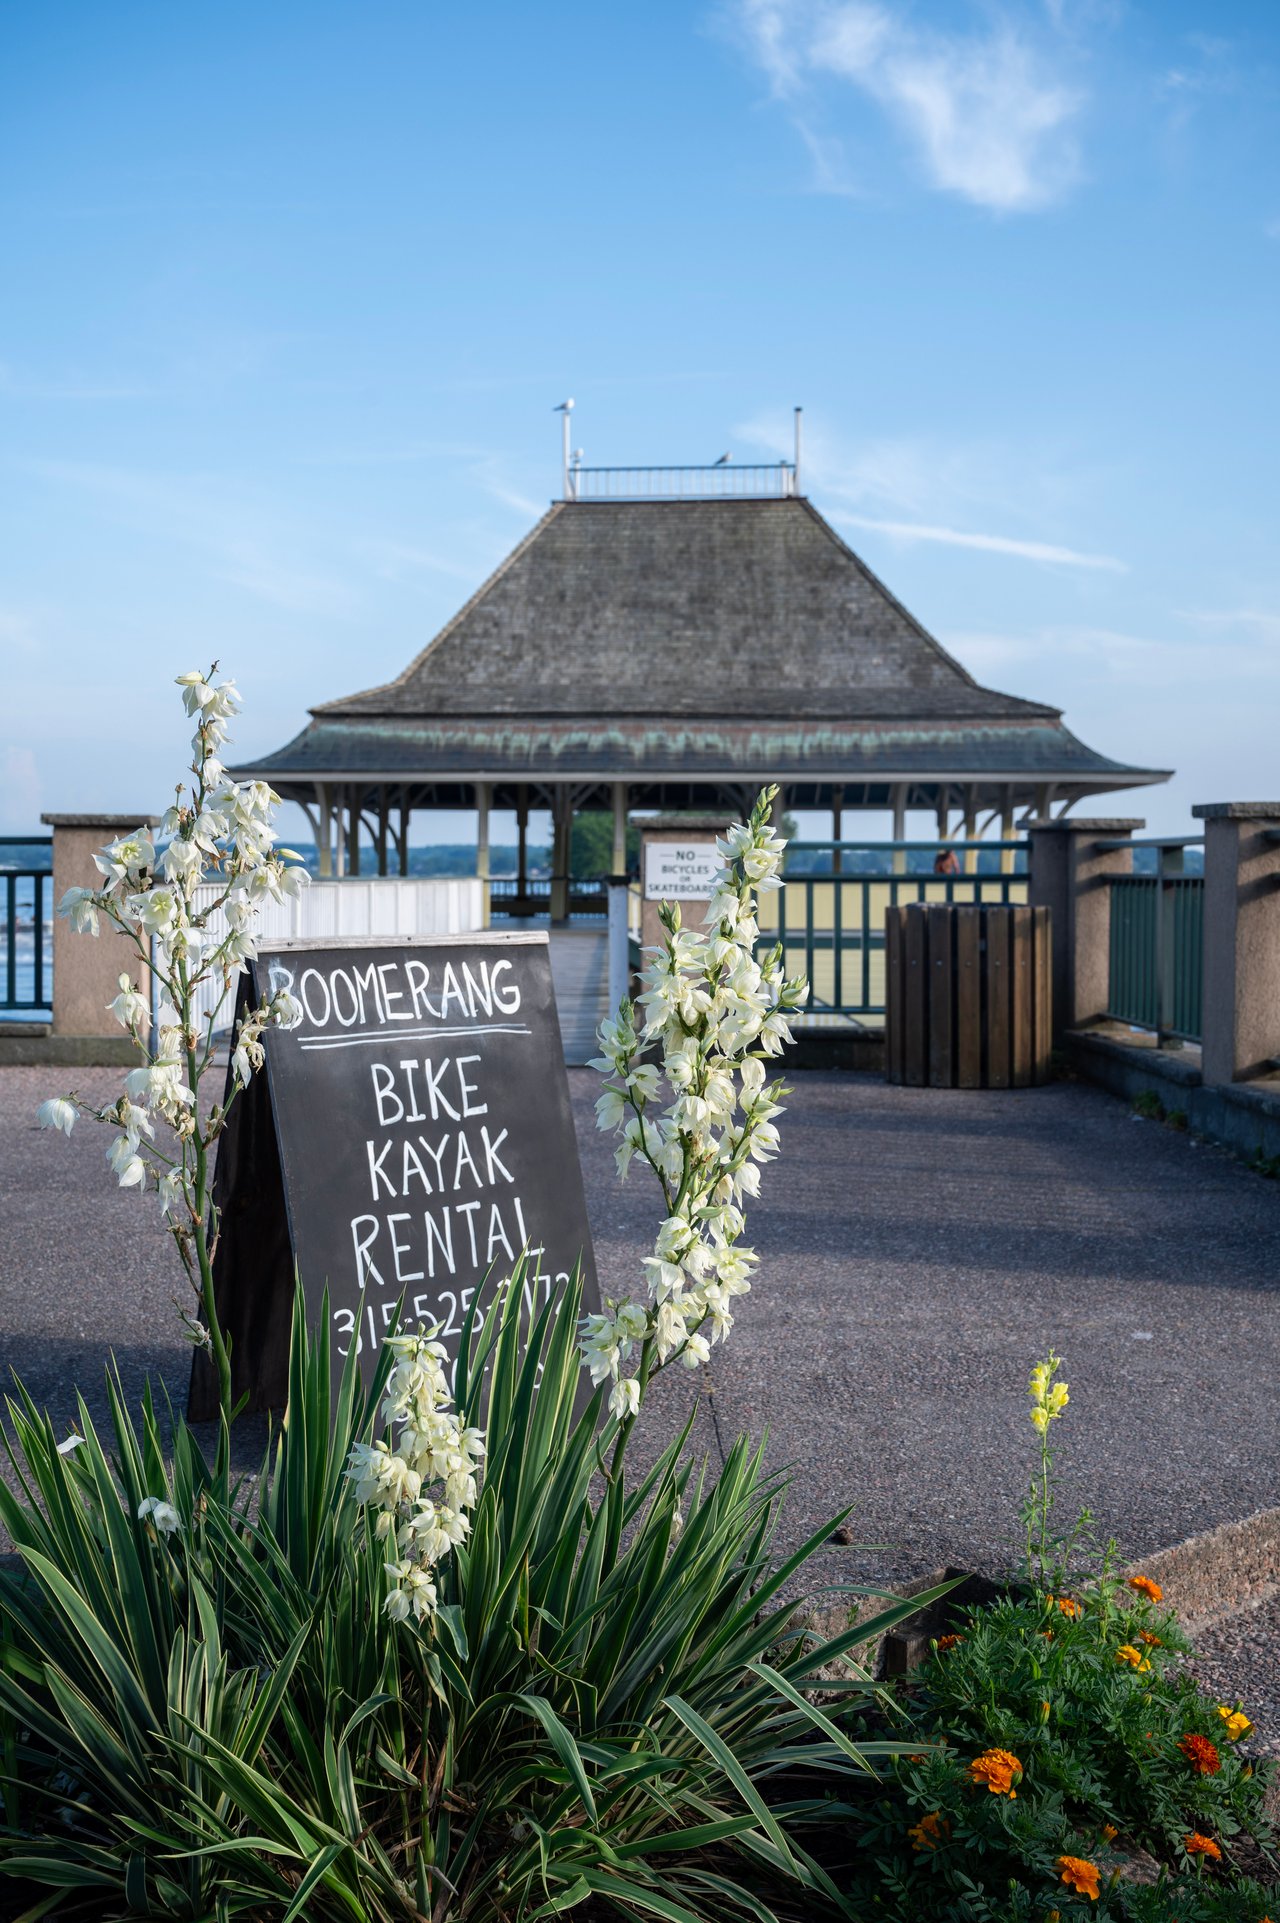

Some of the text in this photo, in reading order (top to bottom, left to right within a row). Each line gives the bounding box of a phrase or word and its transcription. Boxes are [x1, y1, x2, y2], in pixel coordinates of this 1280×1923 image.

[661, 865, 709, 874] BICYCLES
[676, 850, 696, 861] NO
[268, 960, 521, 1030] BOOMERANG
[371, 1055, 488, 1126] BIKE
[366, 1125, 515, 1201] KAYAK
[351, 1197, 546, 1289] RENTAL
